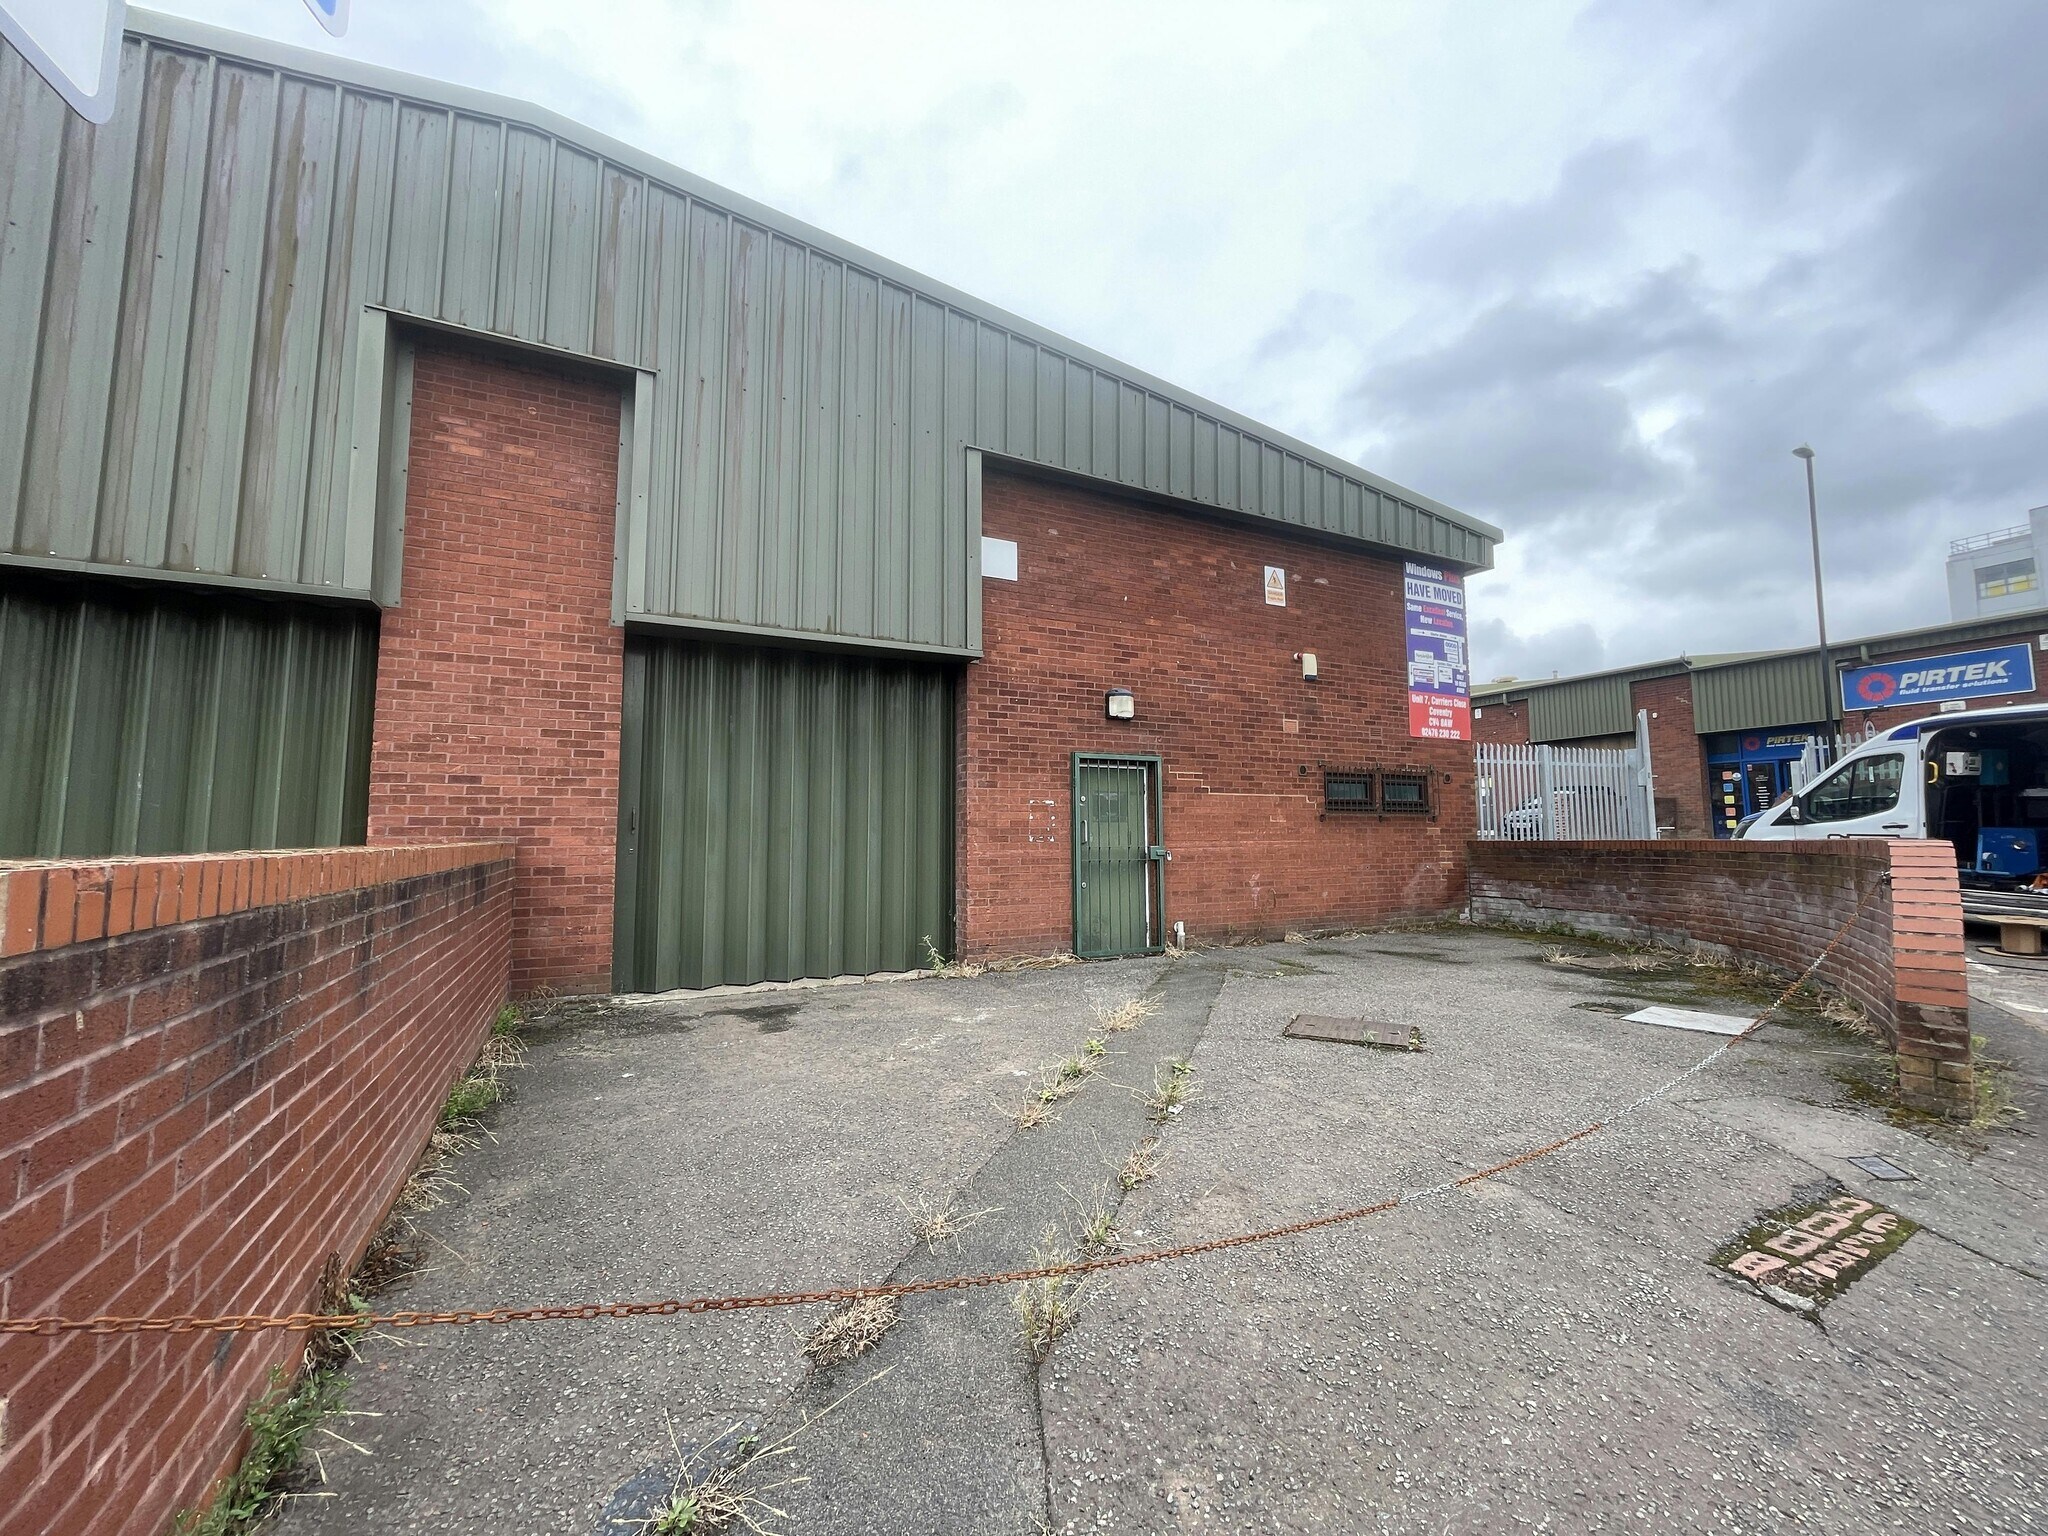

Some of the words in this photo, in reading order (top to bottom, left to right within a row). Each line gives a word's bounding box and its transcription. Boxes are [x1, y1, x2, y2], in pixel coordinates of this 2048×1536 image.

[1407, 582, 1431, 598] HAVE
[1433, 587, 1462, 605] MOVED
[1406, 603, 1422, 613] Same
[1899, 660, 2010, 689] PIRTEK
[1899, 688, 1920, 696] fluid
[1922, 683, 1961, 693] transfer
[1962, 678, 2009, 688] solutions
[1766, 734, 1810, 745] PIRTEK
